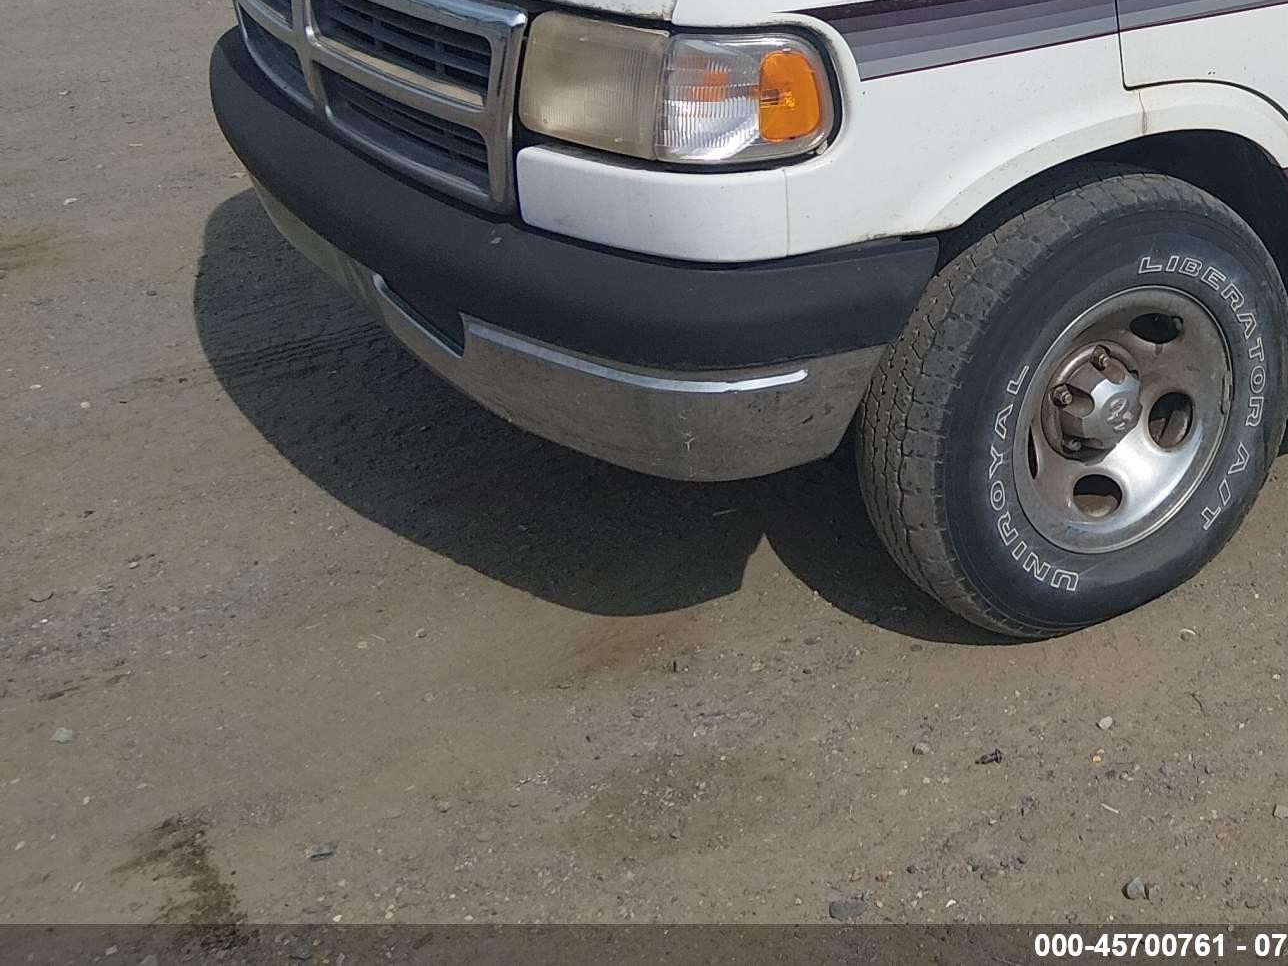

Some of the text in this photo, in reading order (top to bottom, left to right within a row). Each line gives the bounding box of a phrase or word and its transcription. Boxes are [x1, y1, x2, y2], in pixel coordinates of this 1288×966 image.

[988, 365, 1080, 592] UNIROYAL
[1138, 255, 1266, 531] LIBERATOR A/T
